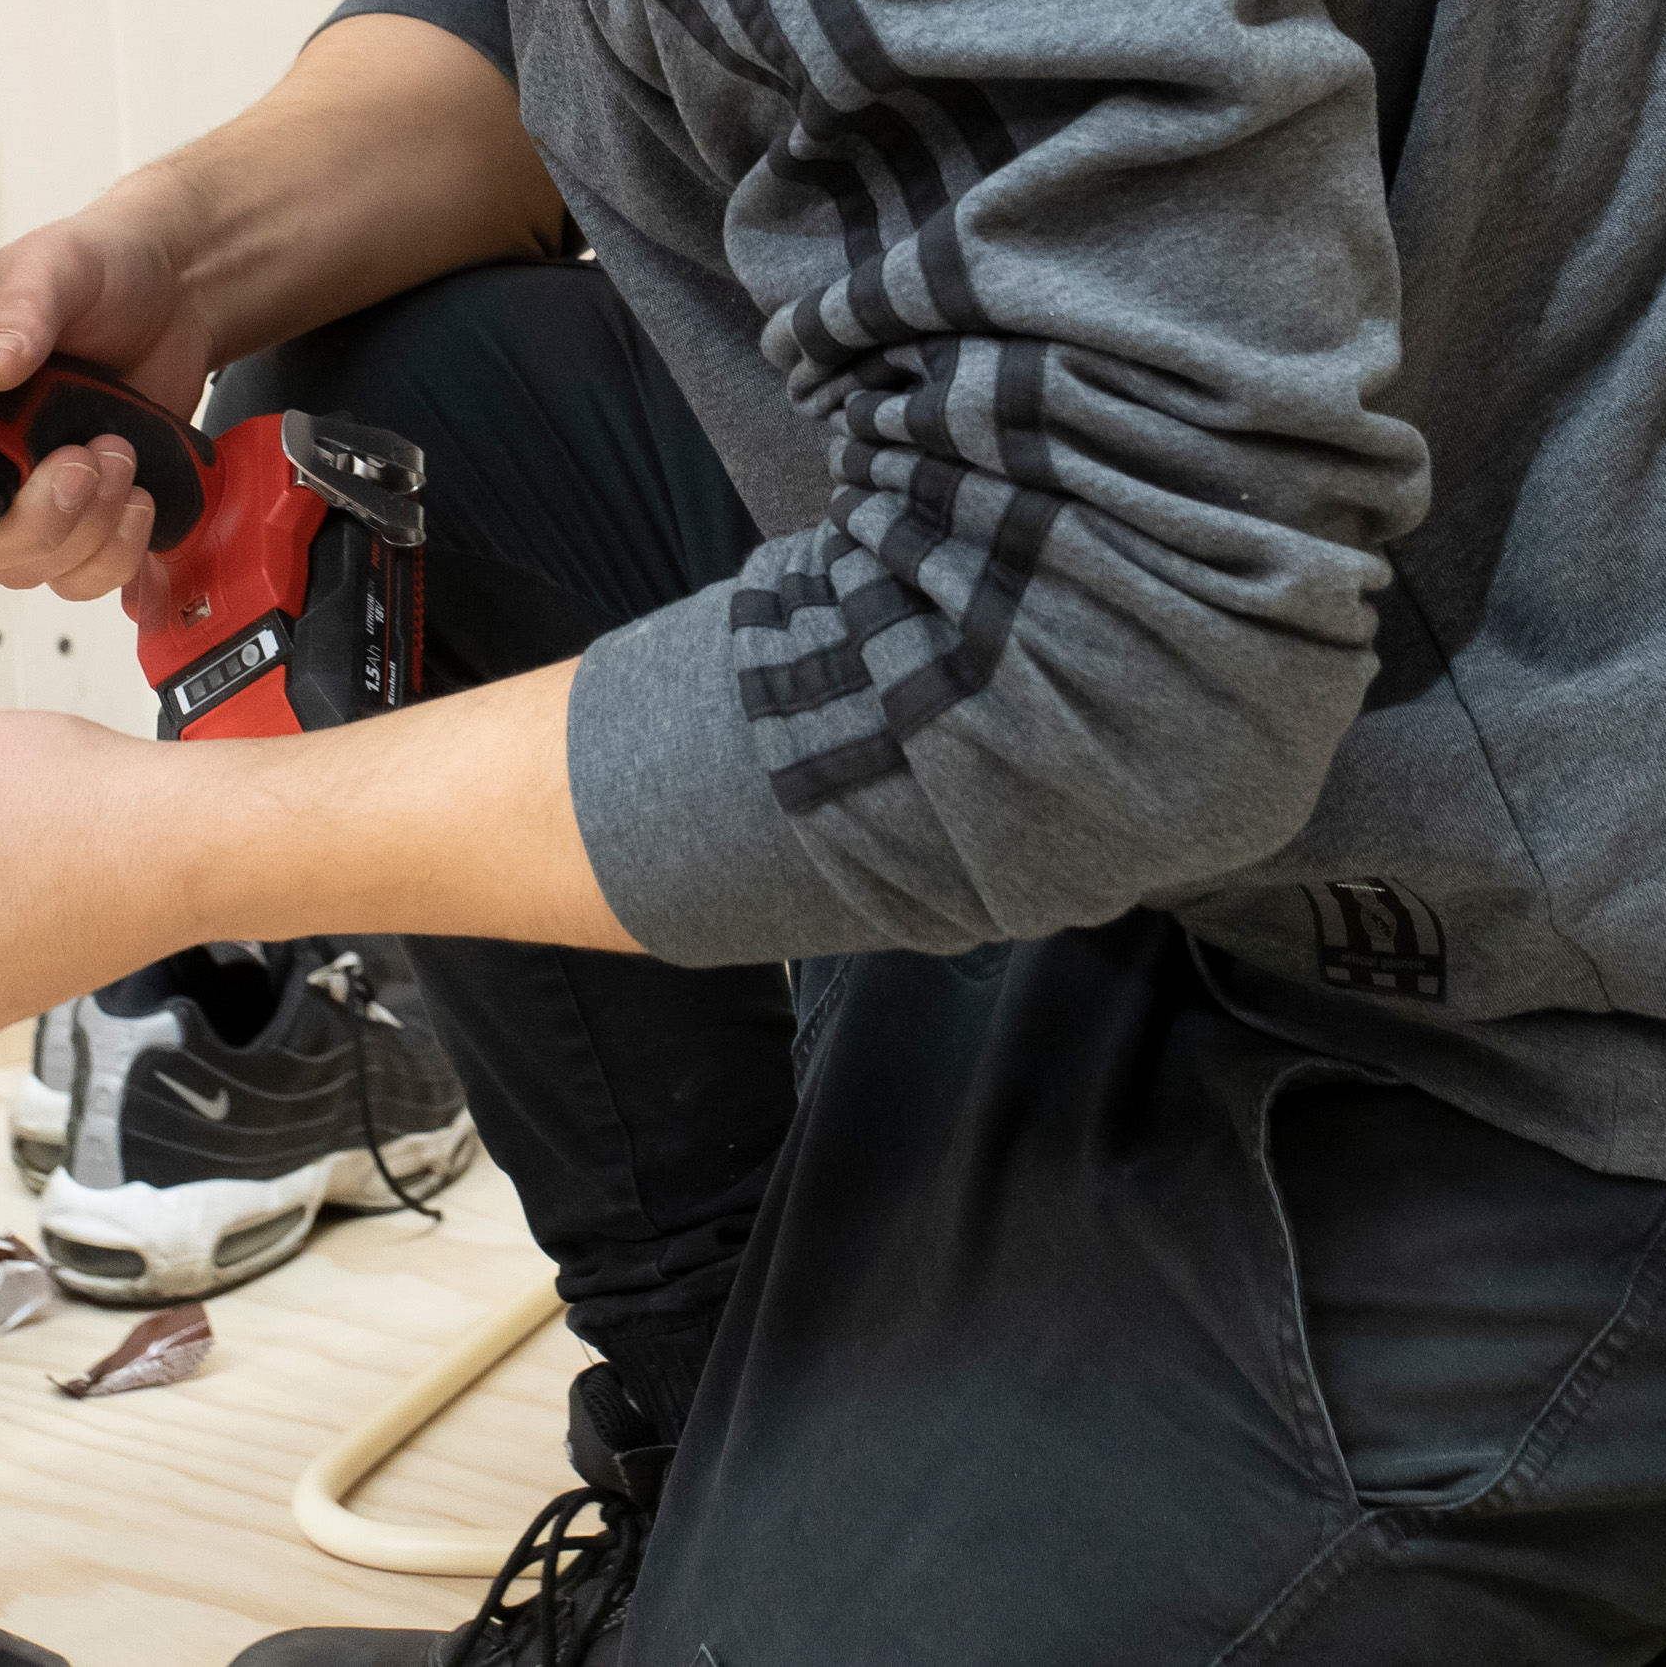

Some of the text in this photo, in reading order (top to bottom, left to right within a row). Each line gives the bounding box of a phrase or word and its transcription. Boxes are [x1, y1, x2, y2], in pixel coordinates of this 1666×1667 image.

[375, 598, 385, 624] 18V
[365, 644, 381, 693] 1.5Ah
[388, 660, 397, 706] Einhell
